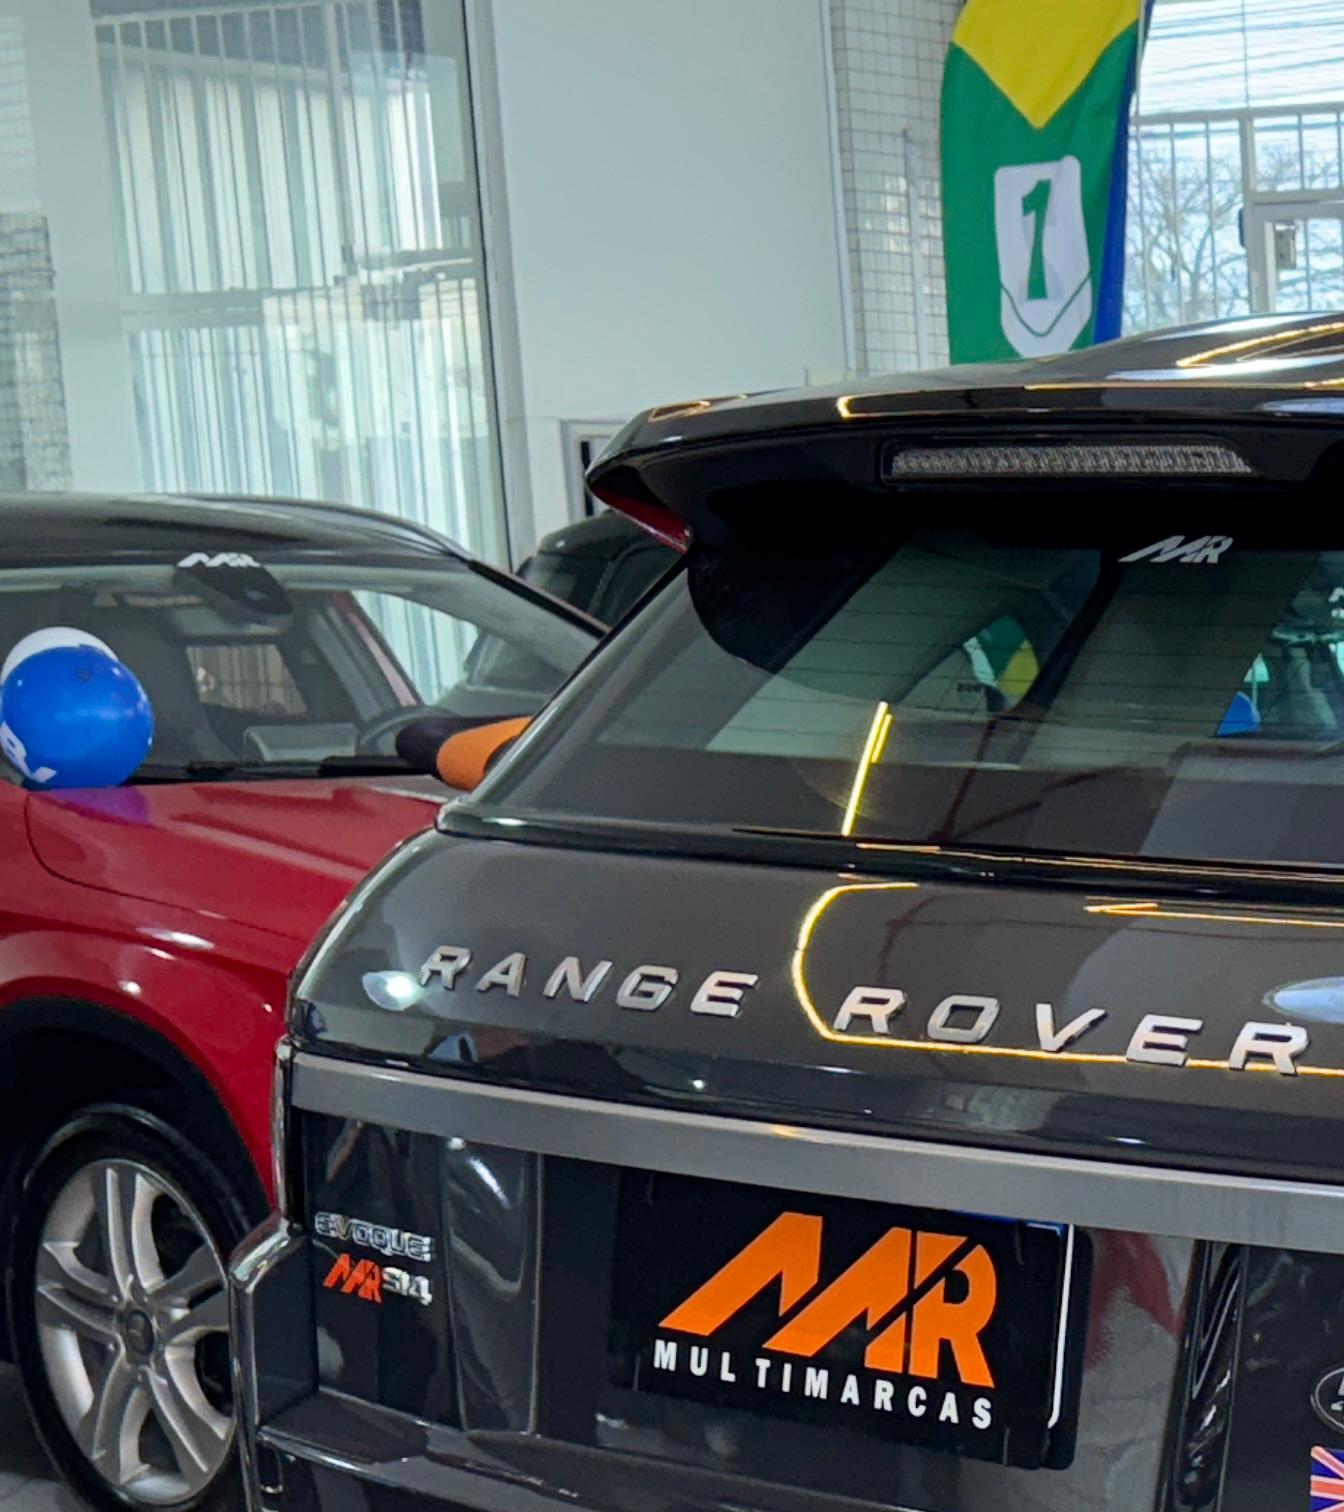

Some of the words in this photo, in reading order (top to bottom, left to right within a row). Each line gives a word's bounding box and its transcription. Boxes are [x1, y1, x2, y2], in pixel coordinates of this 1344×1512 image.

[418, 944, 758, 1017] RANGE
[834, 985, 1311, 1077] ROVER
[314, 1211, 432, 1263] EVOQUE
[657, 1210, 998, 1389] MR
[653, 1339, 995, 1431] MULTIMARCAS
